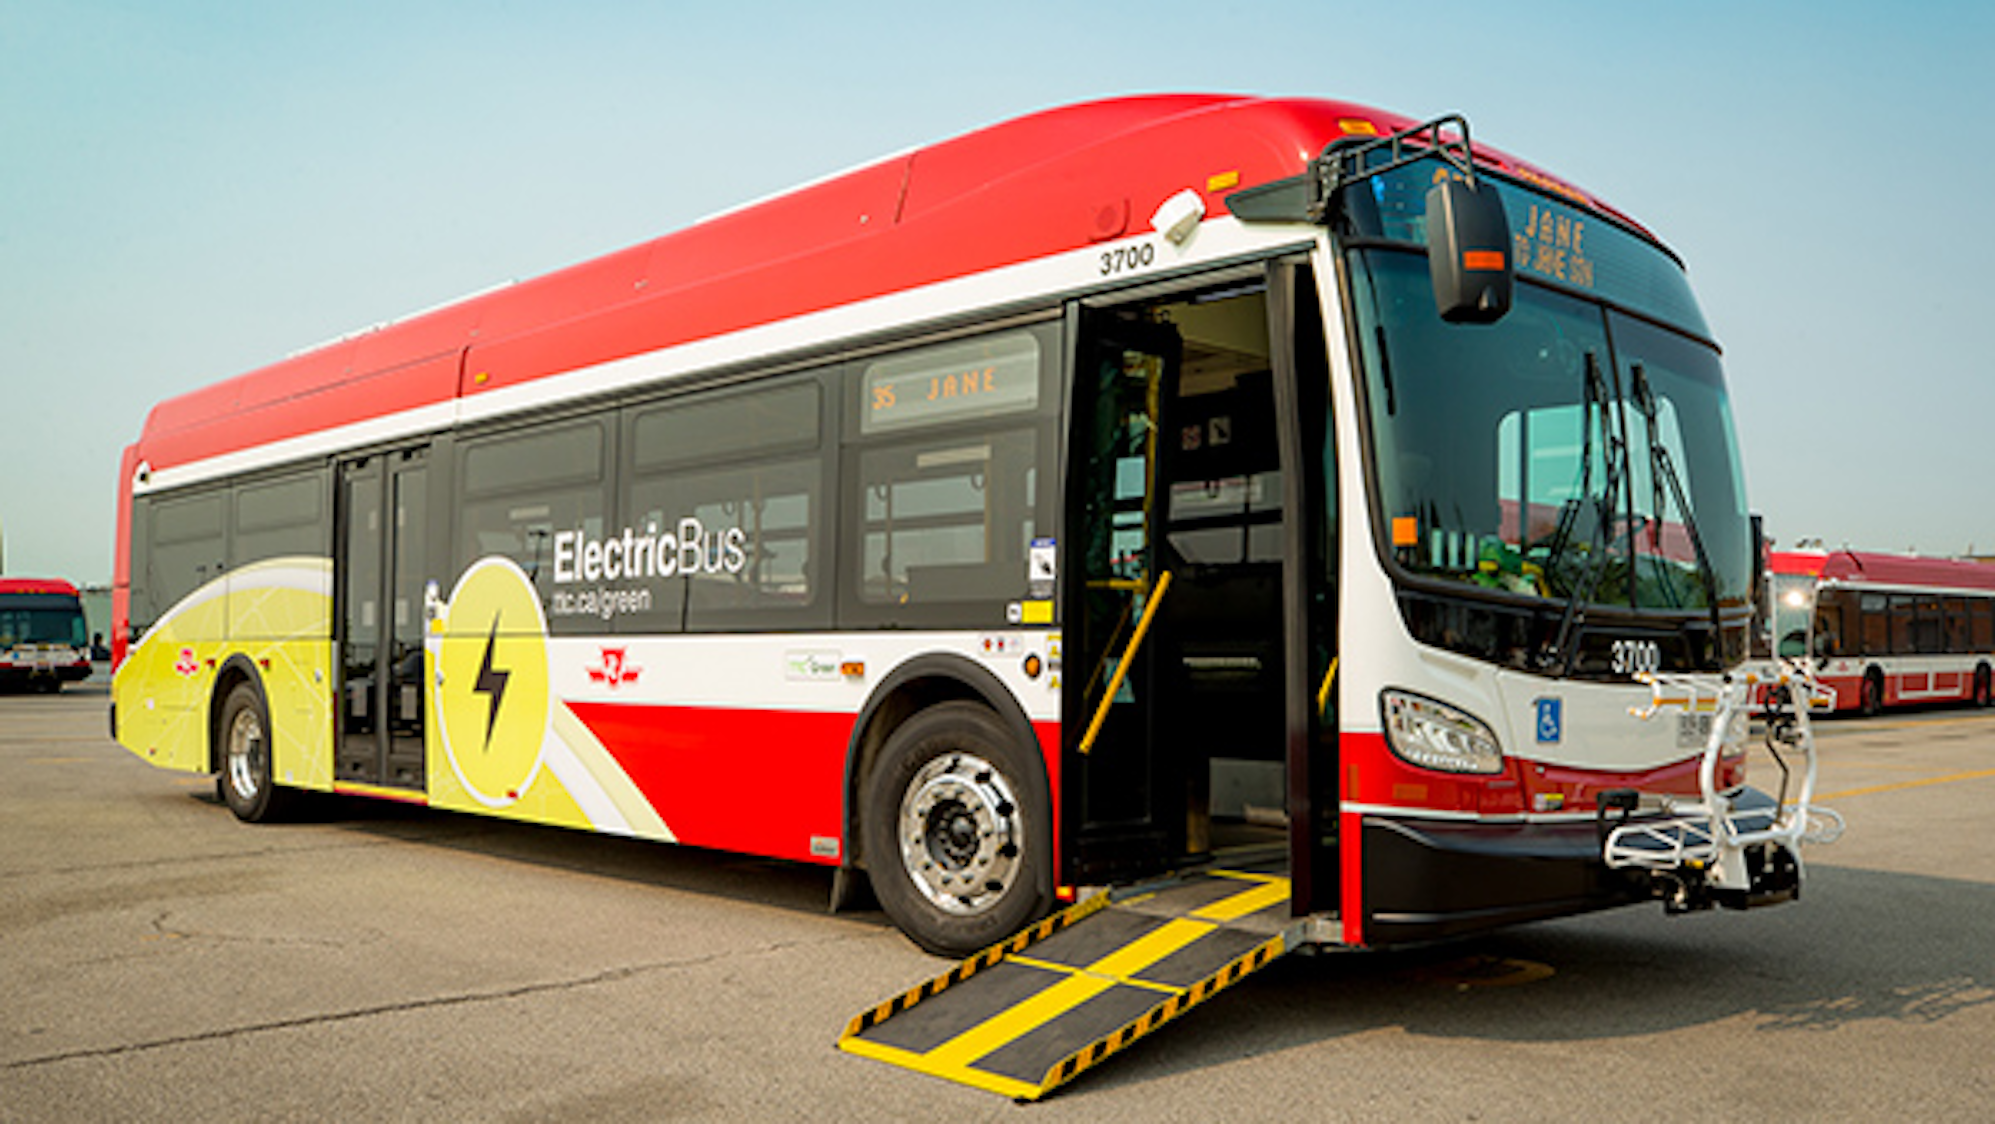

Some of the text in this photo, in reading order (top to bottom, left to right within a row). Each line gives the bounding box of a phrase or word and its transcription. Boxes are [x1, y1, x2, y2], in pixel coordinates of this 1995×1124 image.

[1526, 204, 1584, 254] JANE
[1100, 242, 1154, 276] 3700
[871, 366, 996, 411] 35 JANE
[553, 517, 746, 584] ElectricBus
[1611, 640, 1661, 675] 3700
